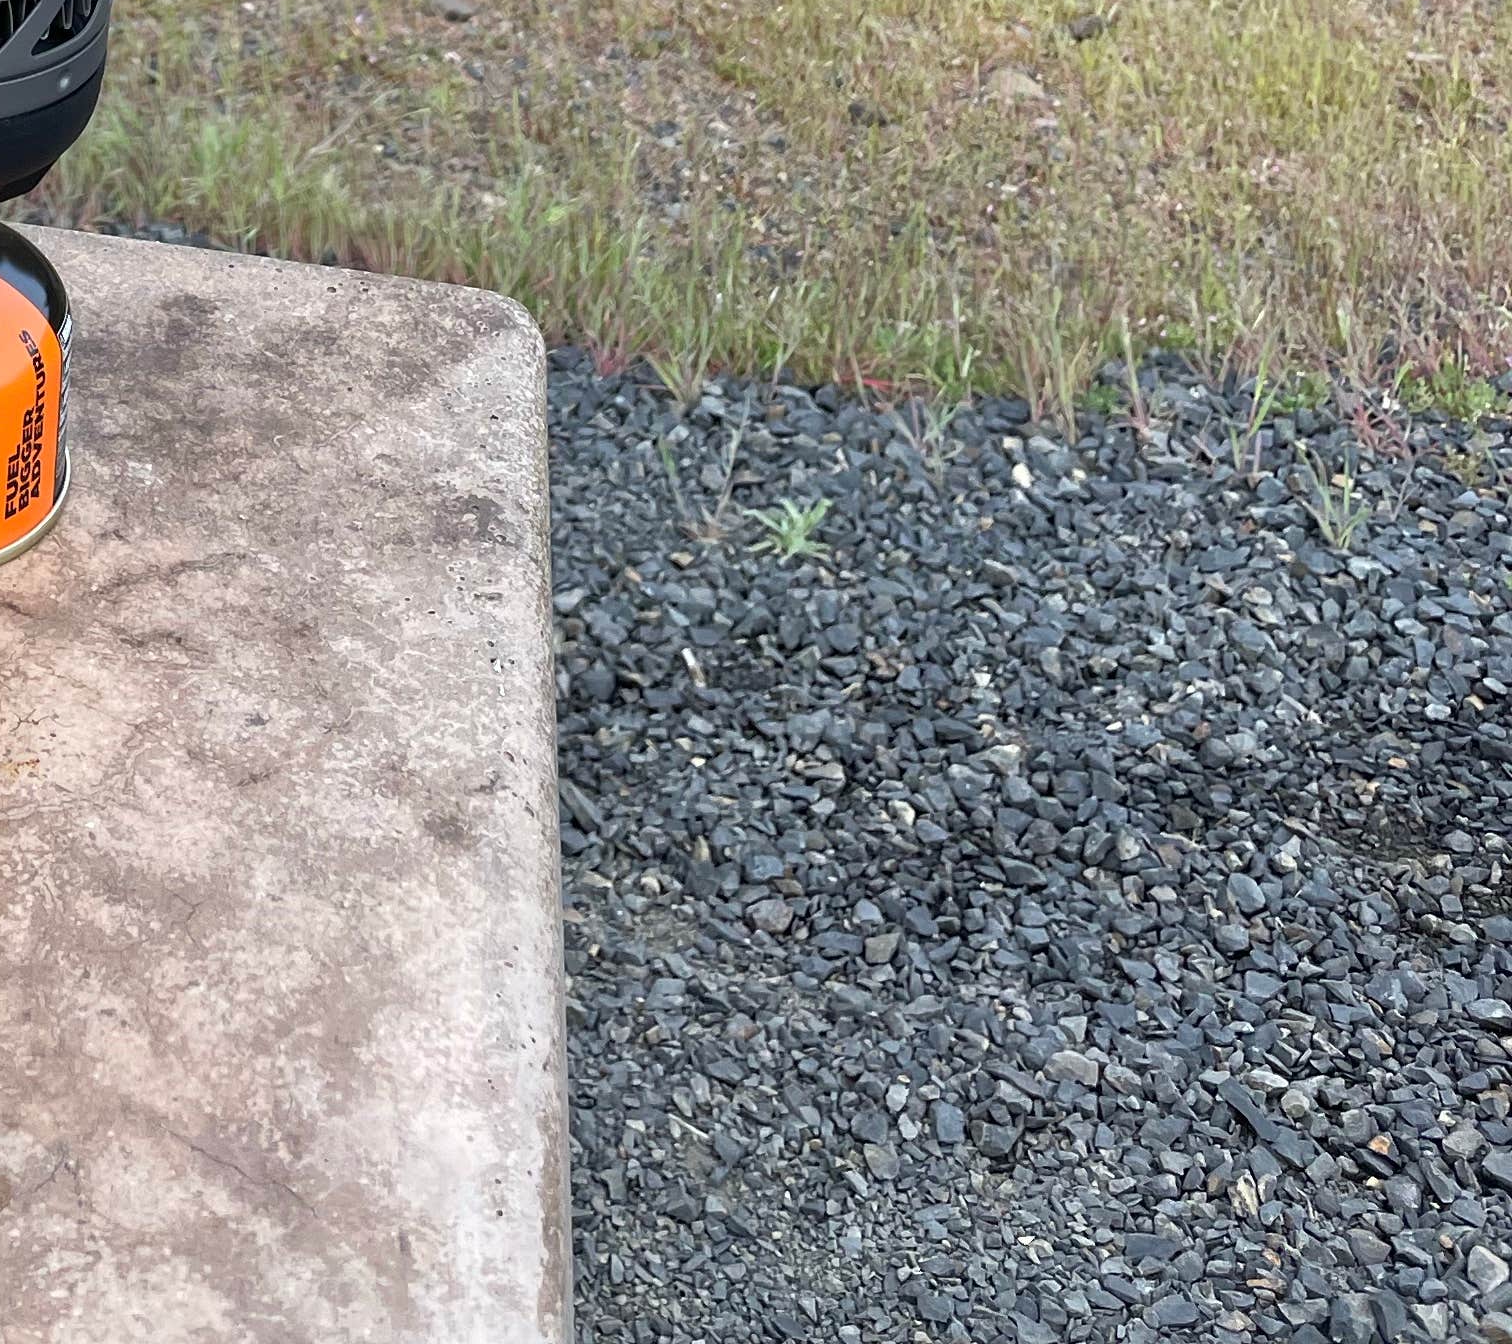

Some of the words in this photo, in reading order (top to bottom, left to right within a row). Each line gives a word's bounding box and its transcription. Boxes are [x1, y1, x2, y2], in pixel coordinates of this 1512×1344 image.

[18, 405, 35, 512] BIGGER
[19, 329, 46, 498] ADVENTURES
[4, 444, 21, 520] FUEL
